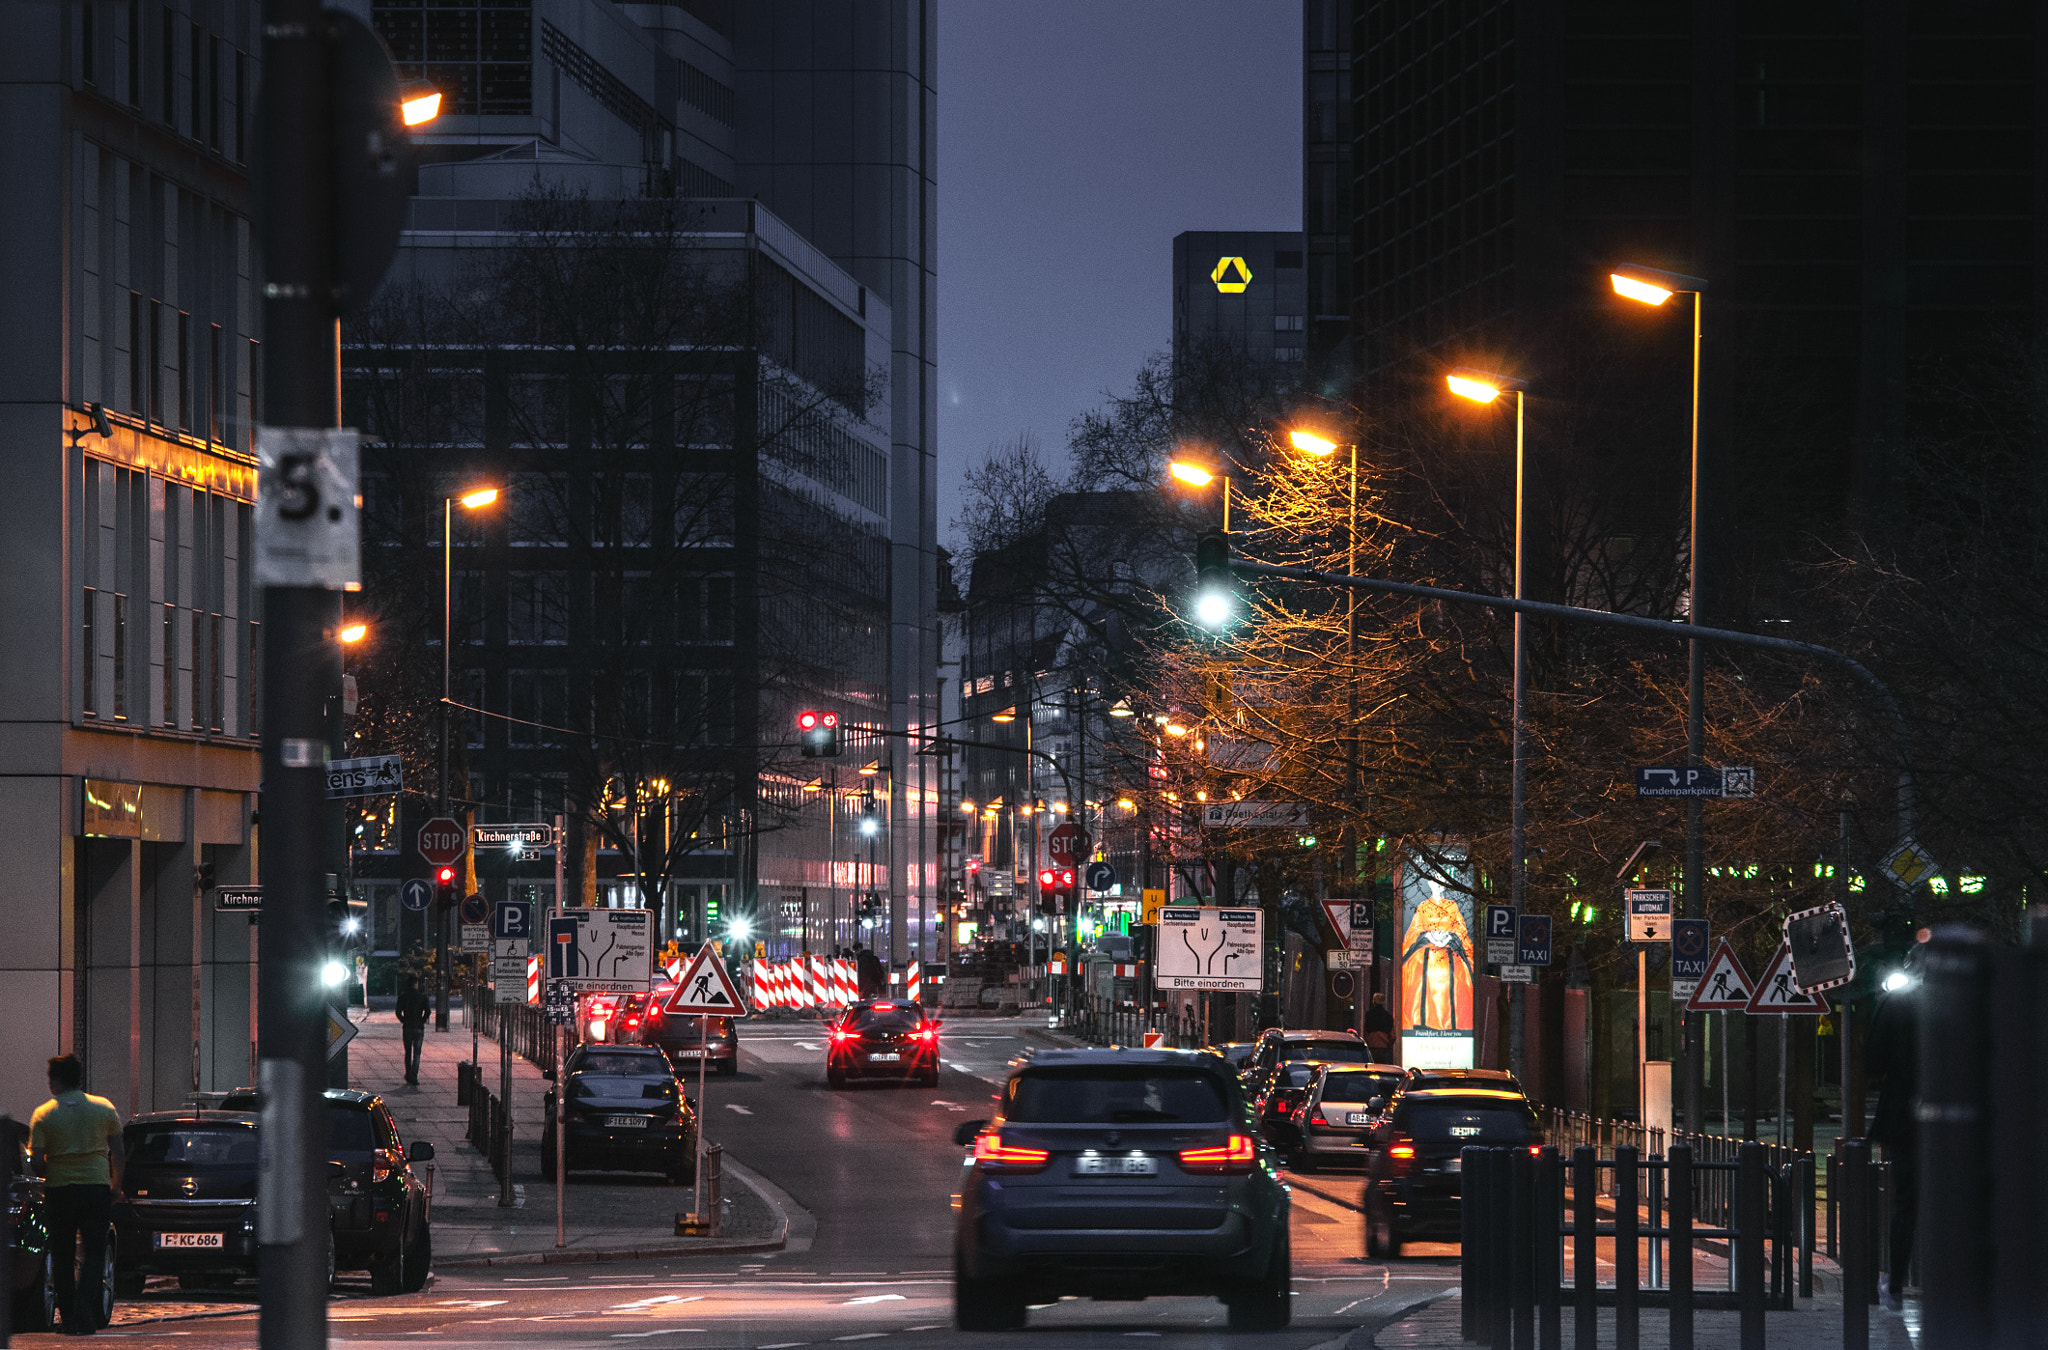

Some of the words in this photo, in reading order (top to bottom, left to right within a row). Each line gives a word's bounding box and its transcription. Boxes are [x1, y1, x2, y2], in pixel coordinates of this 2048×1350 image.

[278, 450, 343, 523] 5.
[1639, 786, 1721, 797] Kundenparkplatz
[423, 832, 460, 851] STOP
[478, 830, 542, 844] Kirchnerstraße
[1632, 893, 1670, 902] PARKSCHEIN-
[1354, 903, 1367, 925] P
[1638, 903, 1664, 912] AUTOMAT
[503, 906, 523, 934] P
[1493, 909, 1510, 935] P
[1521, 950, 1548, 961] TAXI
[1675, 960, 1705, 974] TAXI
[586, 981, 634, 991] einordnen
[1174, 979, 1195, 987] Bitte
[1198, 979, 1245, 988] einordnen
